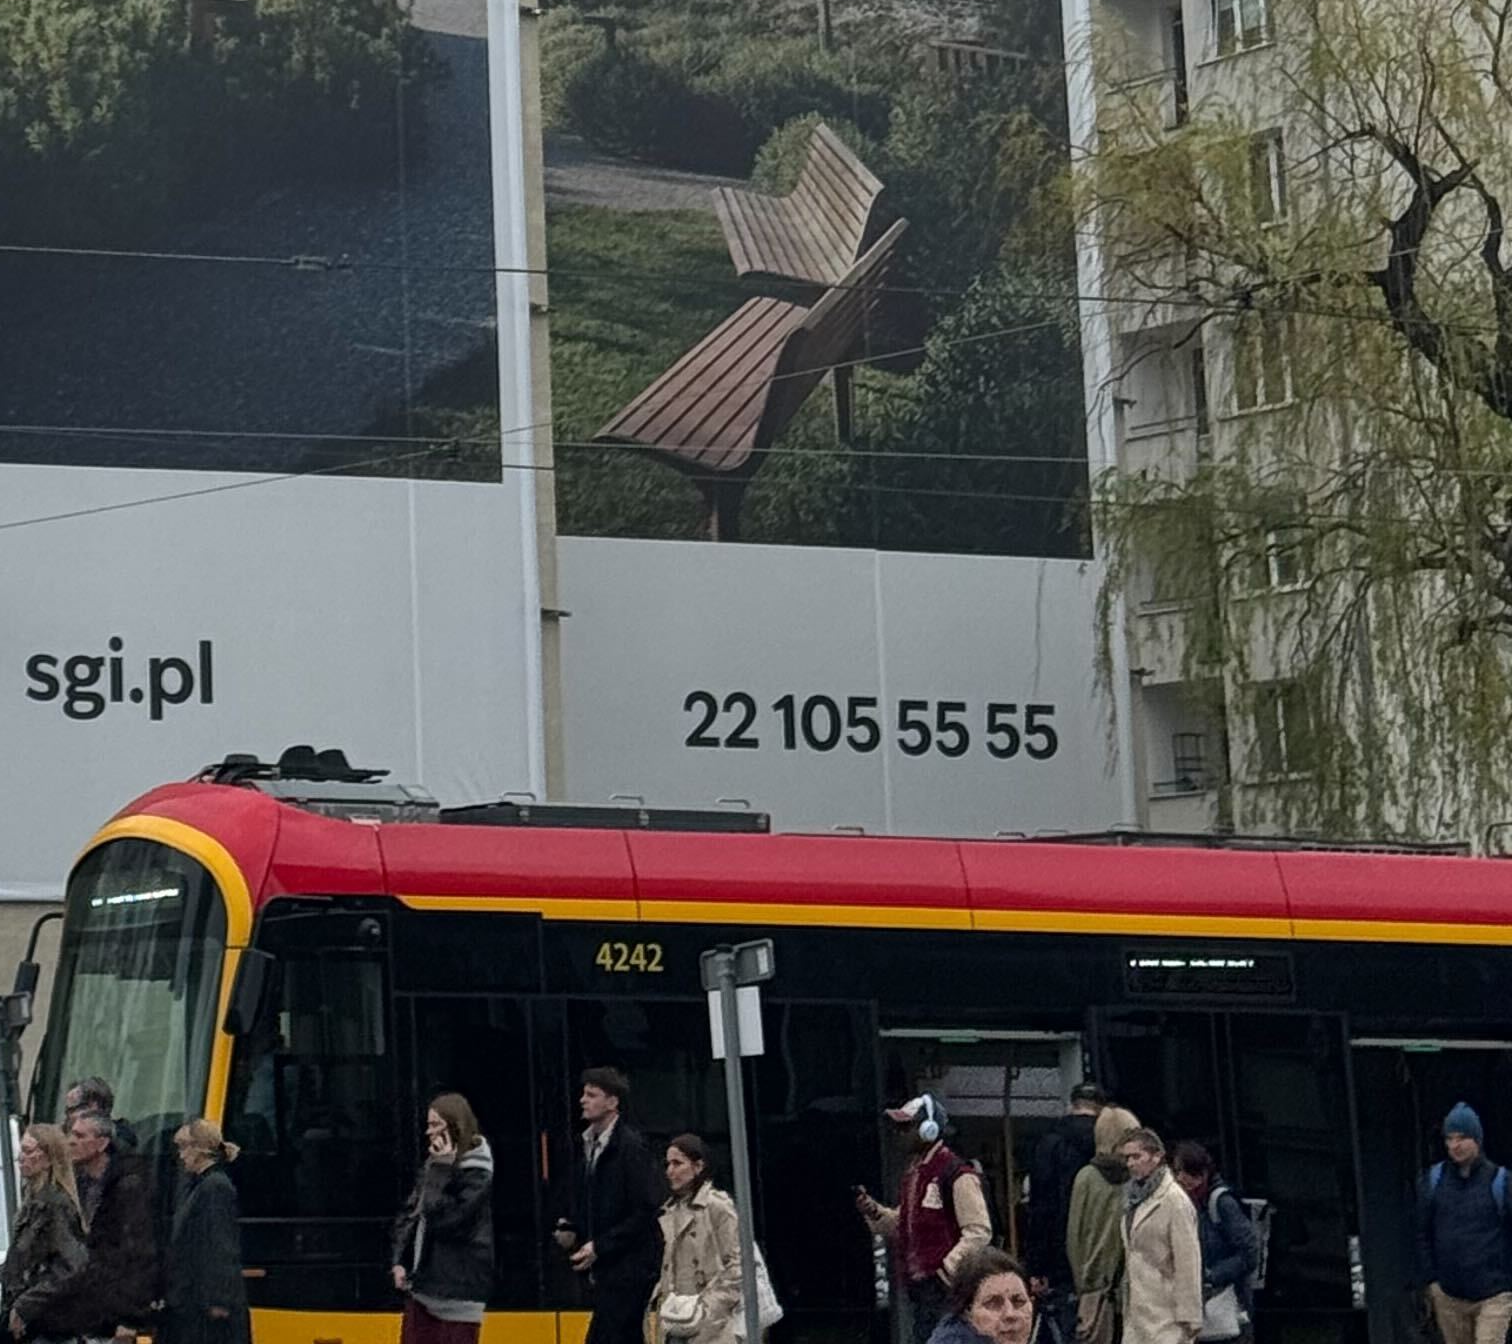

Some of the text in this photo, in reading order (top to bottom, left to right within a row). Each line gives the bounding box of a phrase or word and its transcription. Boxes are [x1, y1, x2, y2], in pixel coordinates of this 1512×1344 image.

[26, 636, 214, 721] sgi.pl
[683, 690, 1059, 761] 22 105 55 55
[595, 942, 665, 972] 4242
